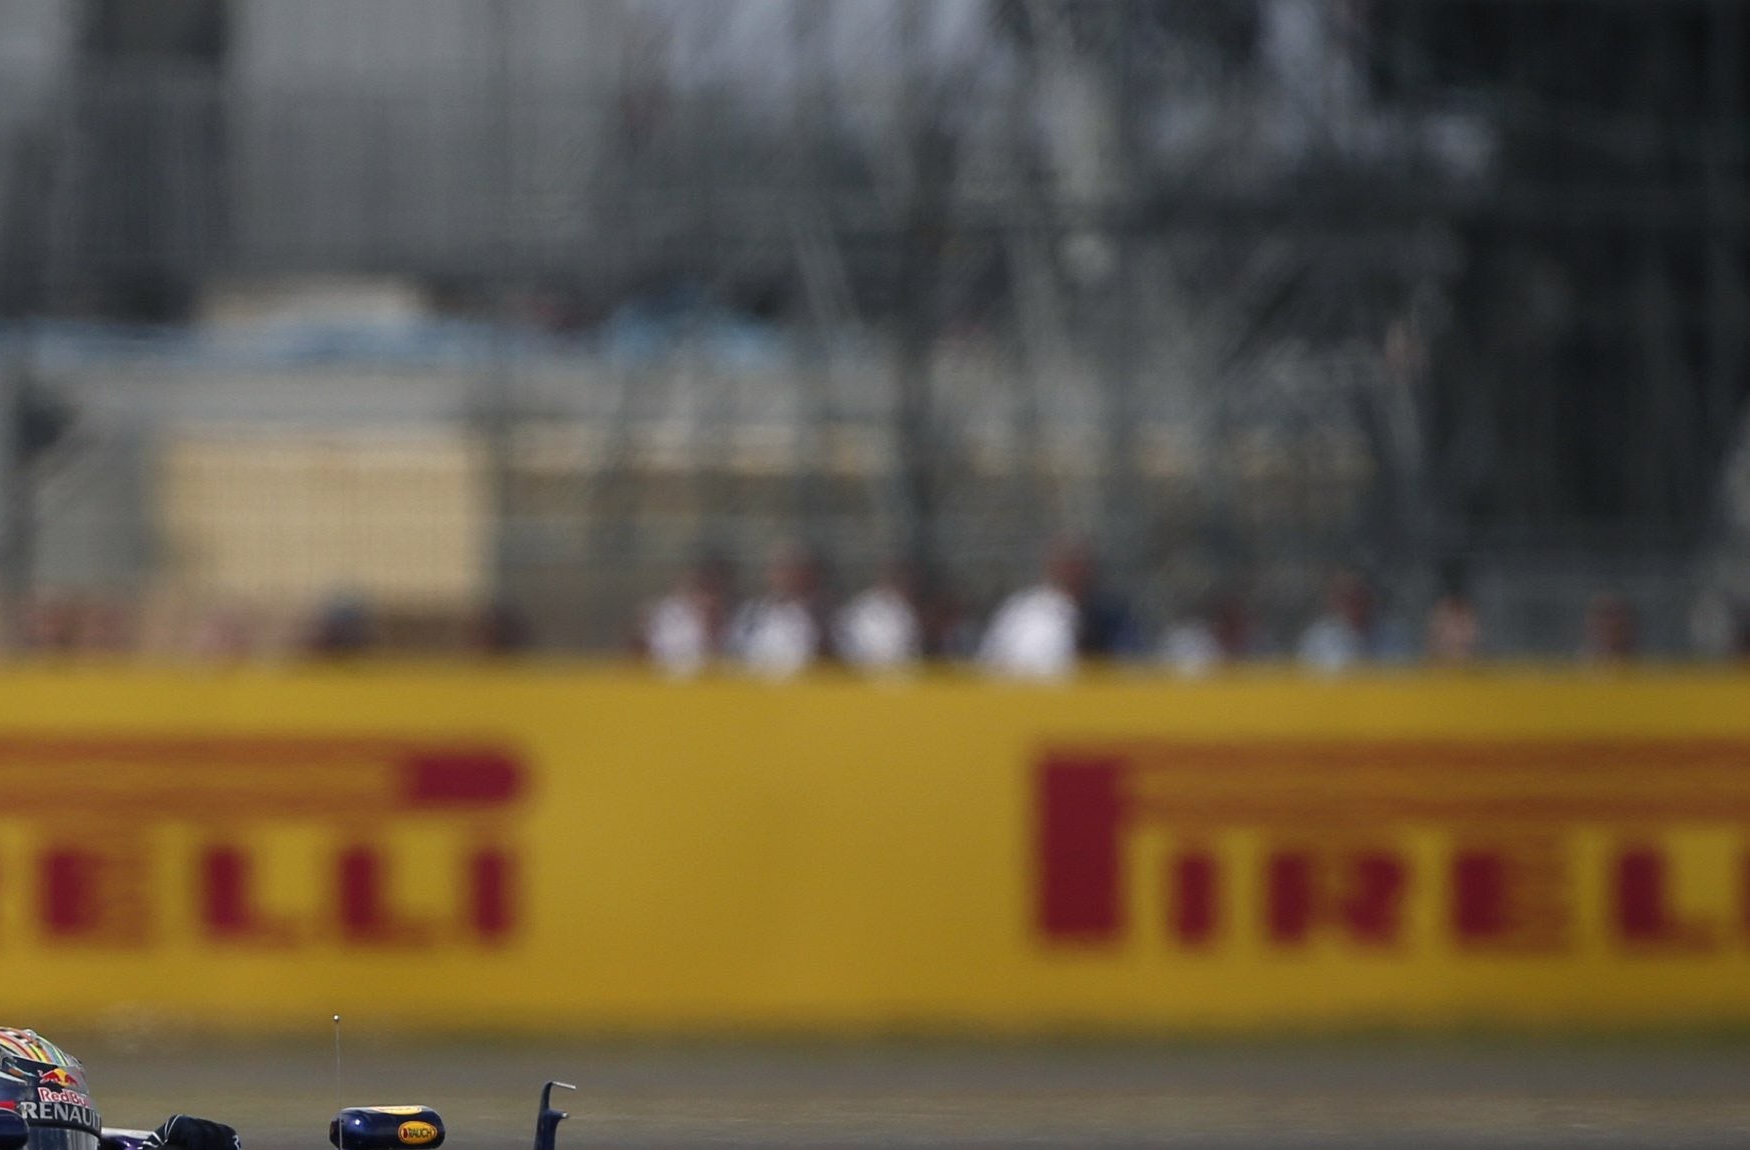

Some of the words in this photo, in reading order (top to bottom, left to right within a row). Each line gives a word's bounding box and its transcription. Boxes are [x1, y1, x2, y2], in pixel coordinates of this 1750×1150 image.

[1035, 737, 1750, 952] PIREL
[38, 1087, 70, 1103] Red
[21, 1101, 101, 1130] RENAULT
